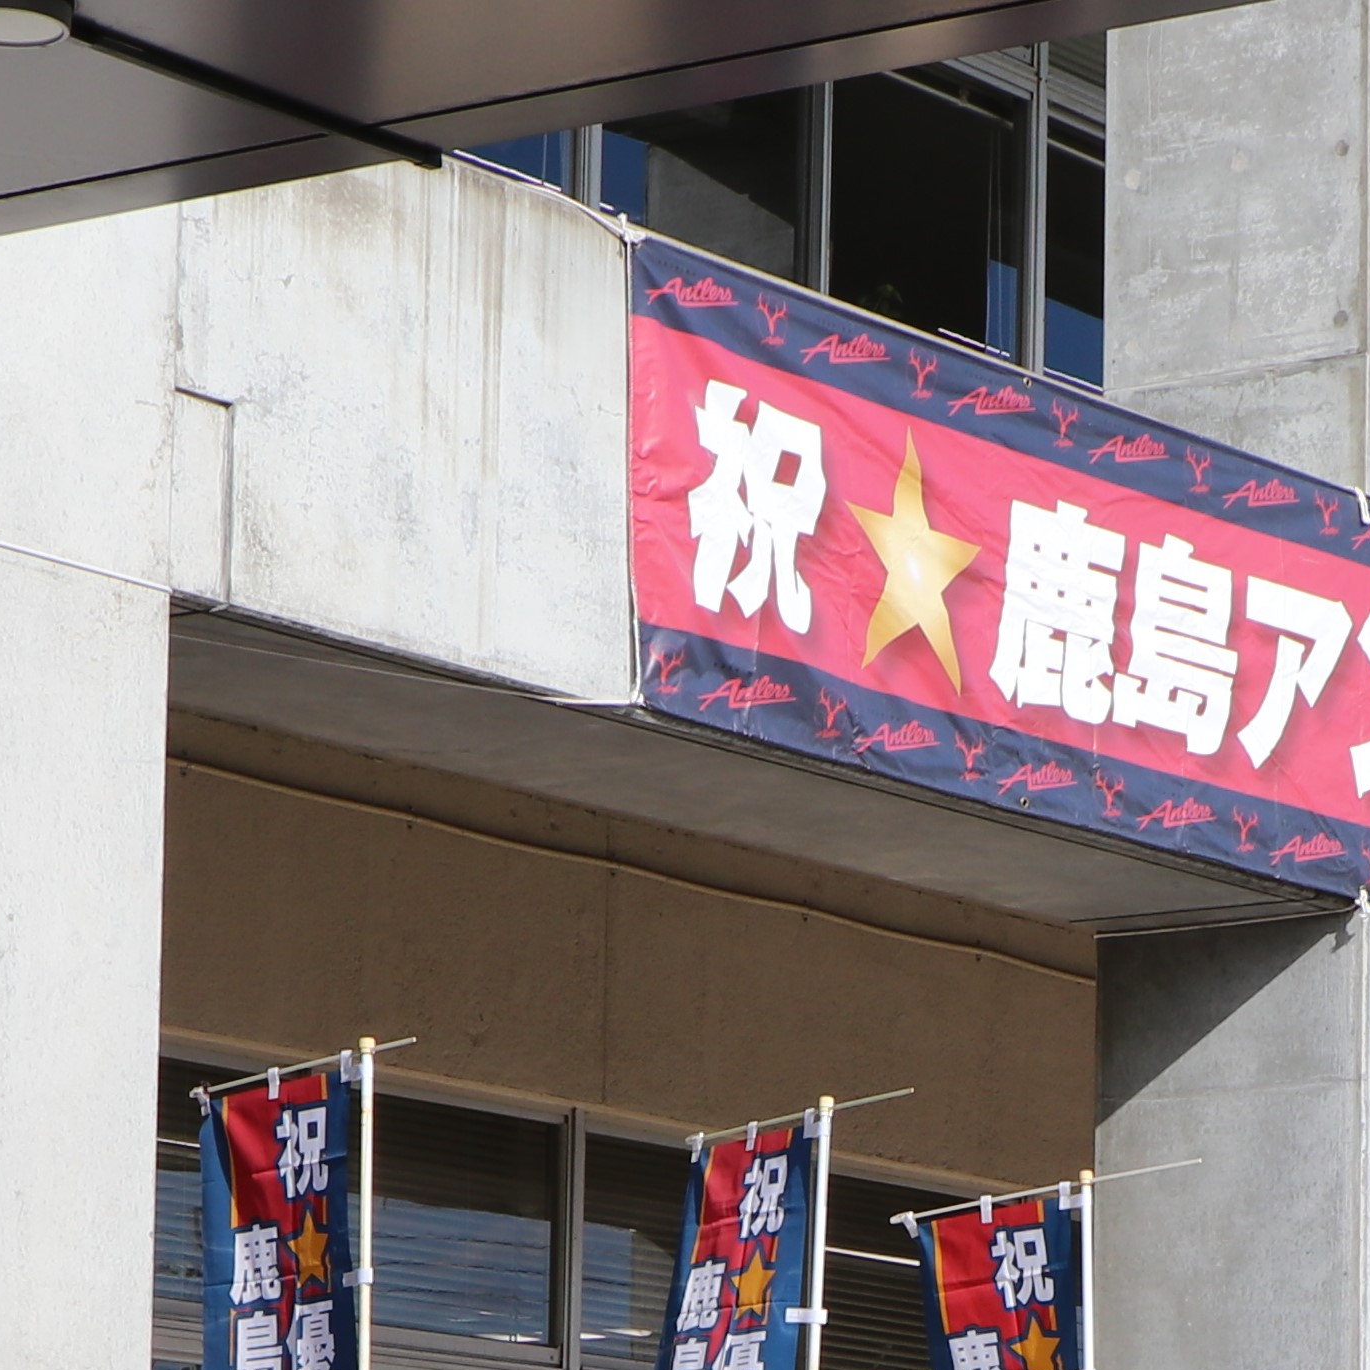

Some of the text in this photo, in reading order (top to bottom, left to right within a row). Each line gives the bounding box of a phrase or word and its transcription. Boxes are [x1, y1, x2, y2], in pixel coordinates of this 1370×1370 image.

[645, 277, 739, 307] Antlers
[800, 333, 891, 364] Antlers
[947, 385, 1036, 416] Antlers
[1088, 433, 1170, 464] Antlers
[1223, 479, 1300, 509] Antlers
[687, 379, 827, 635] 祝
[698, 675, 796, 711] Antlers
[853, 720, 941, 754] Antlers
[997, 761, 1077, 796] Antlers
[1136, 797, 1217, 831] Antlers
[1269, 832, 1348, 866] Antlers
[276, 1106, 329, 1199] 祝
[739, 1154, 788, 1239] 祝
[991, 1228, 1055, 1309] 祝
